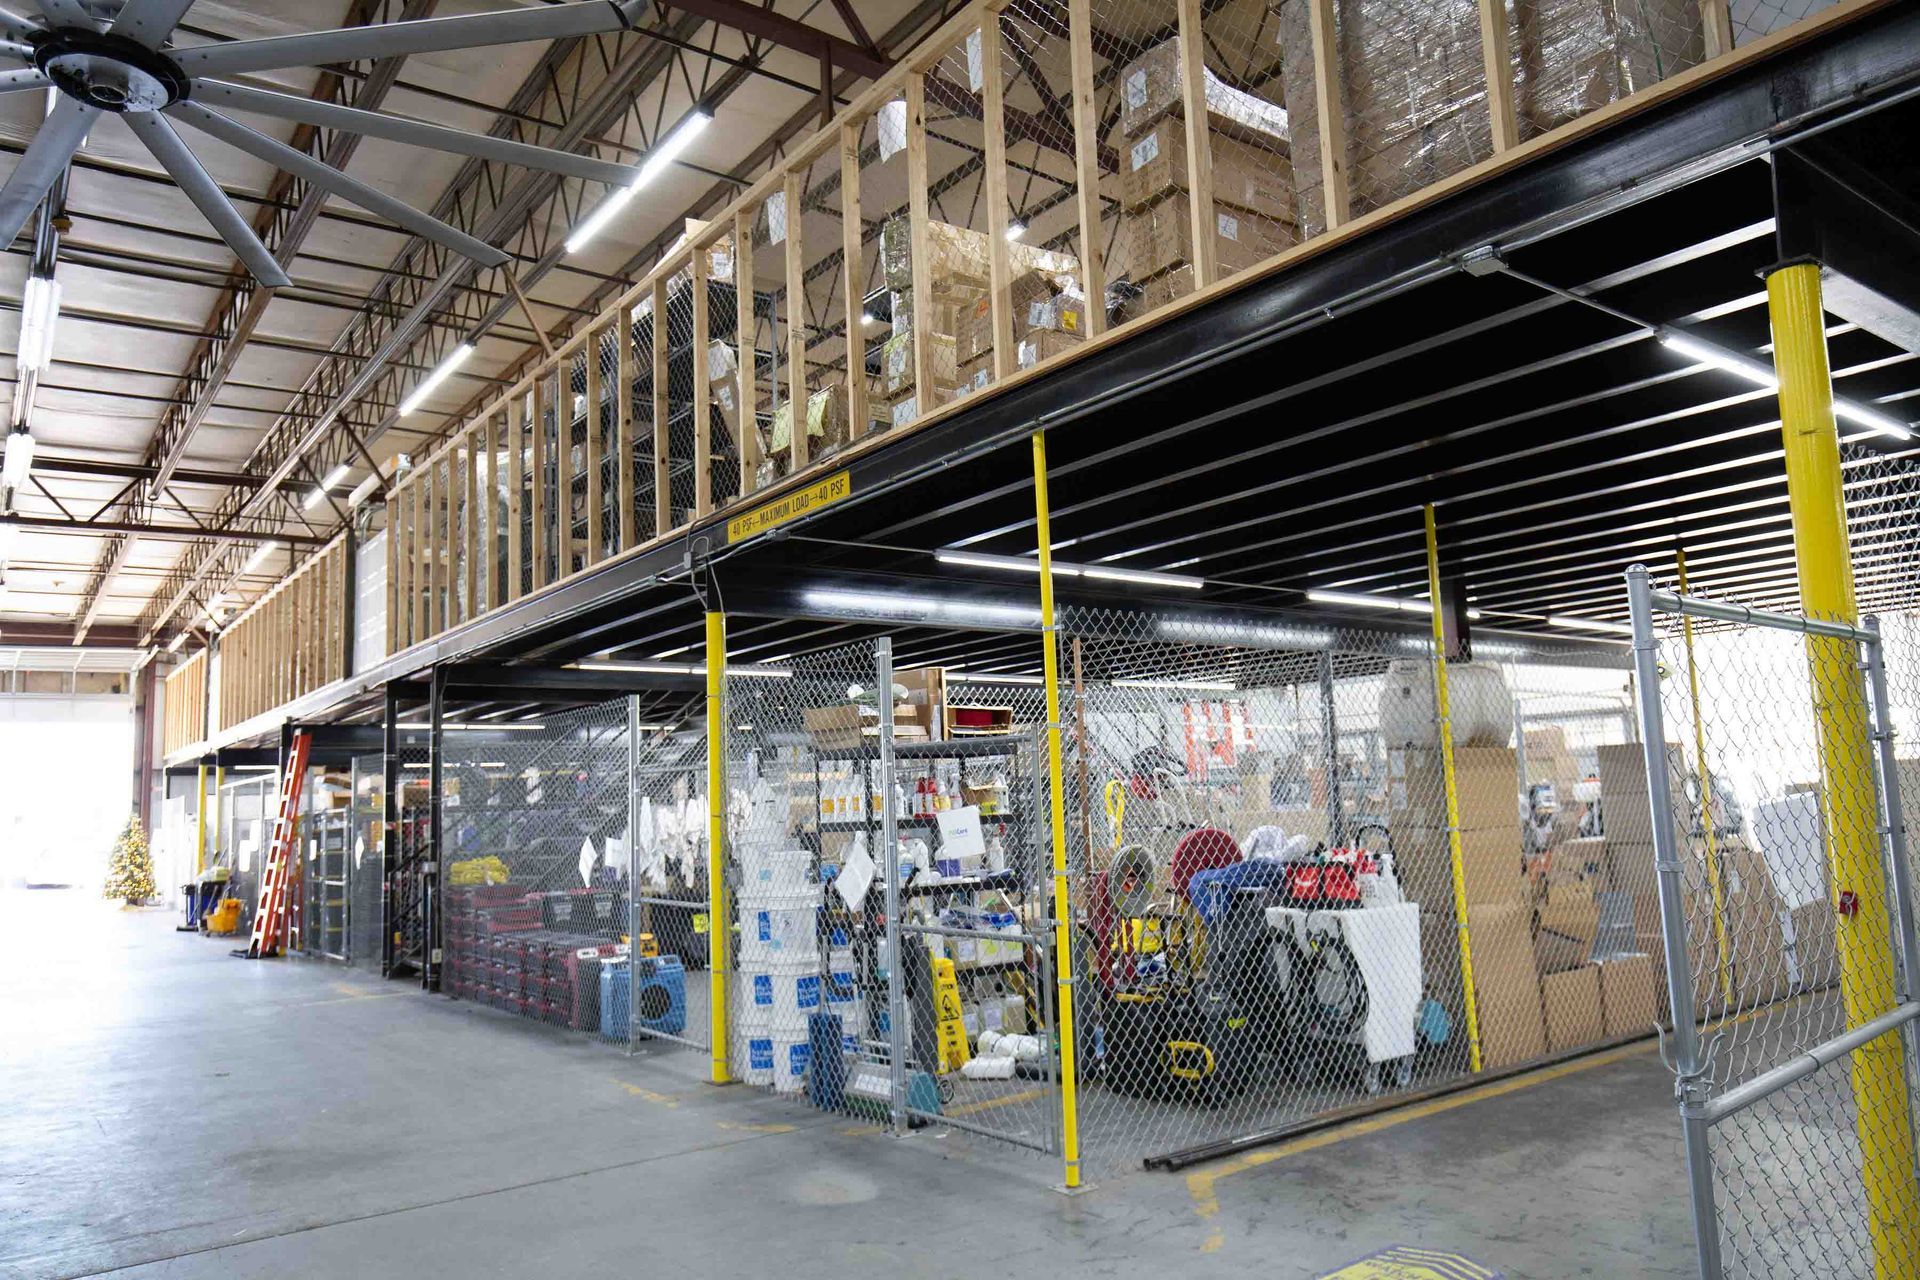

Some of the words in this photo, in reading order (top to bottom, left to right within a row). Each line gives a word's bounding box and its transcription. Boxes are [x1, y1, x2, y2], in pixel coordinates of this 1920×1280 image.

[733, 522, 740, 536] 40
[742, 517, 752, 533] PSF
[760, 501, 789, 525] MAXIMUM
[792, 494, 809, 512] LOAD
[819, 486, 828, 501] 40
[831, 479, 844, 497] PSF
